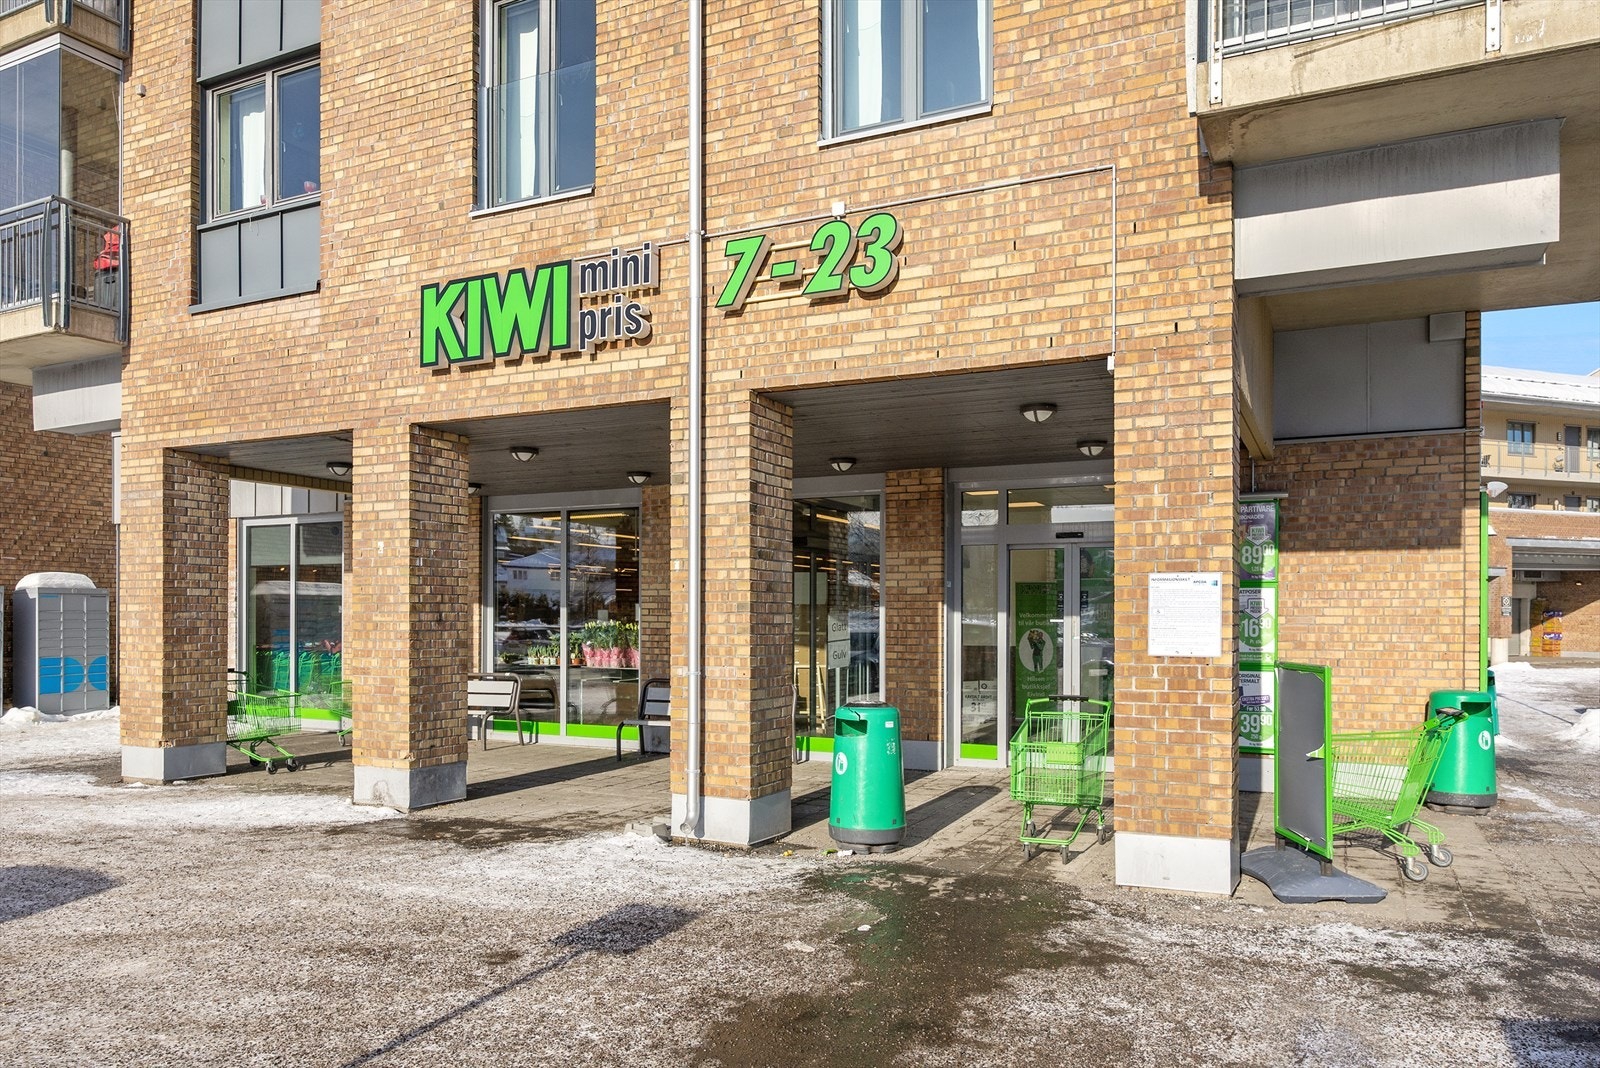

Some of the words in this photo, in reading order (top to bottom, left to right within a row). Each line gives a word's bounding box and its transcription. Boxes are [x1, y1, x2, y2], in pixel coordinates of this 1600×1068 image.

[579, 243, 653, 295] mini
[420, 259, 571, 368] KIWI
[579, 293, 645, 351] pris
[832, 650, 847, 660] Gulv
